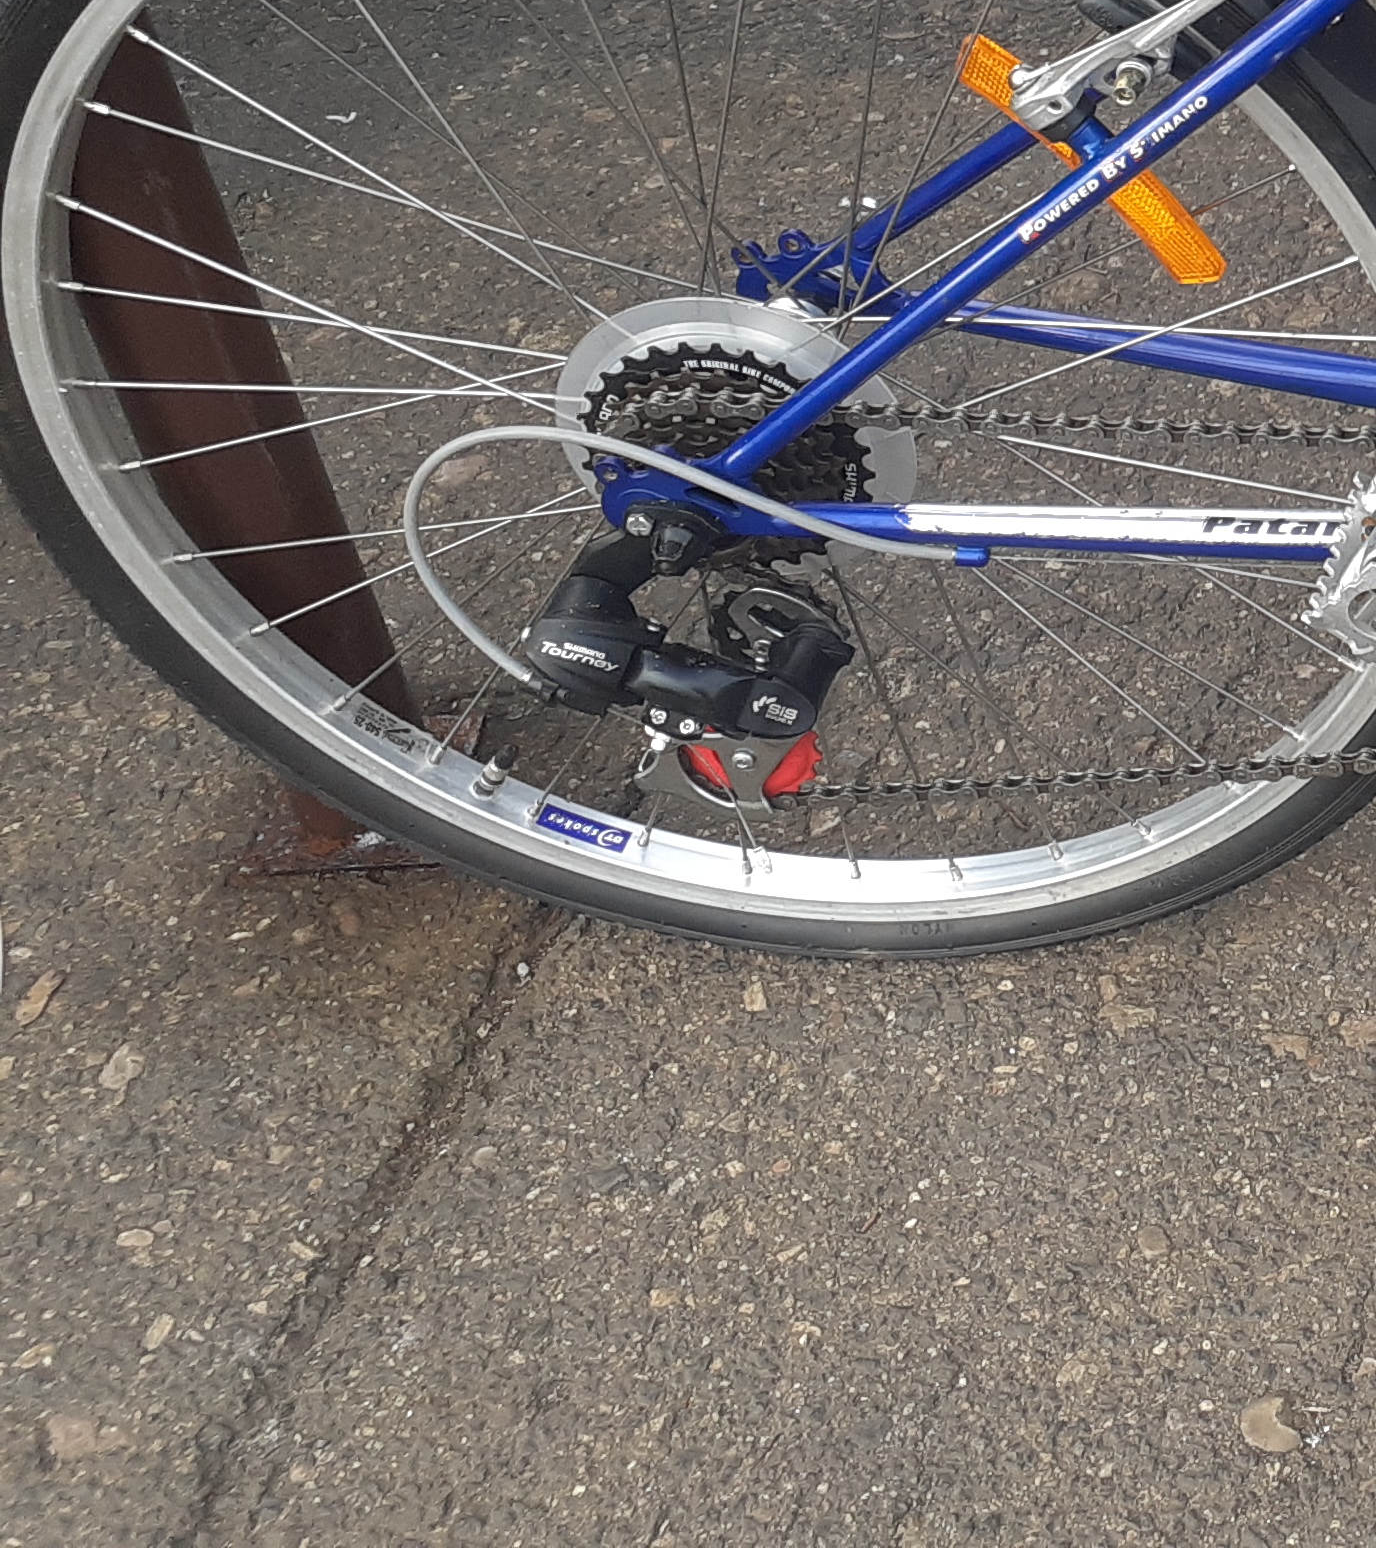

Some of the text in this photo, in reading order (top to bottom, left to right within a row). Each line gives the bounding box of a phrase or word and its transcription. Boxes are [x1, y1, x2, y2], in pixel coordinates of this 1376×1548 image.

[1018, 95, 1208, 243] POWERED BY SIMANO
[541, 640, 619, 672] Tourney
[768, 703, 798, 720] SIS
[547, 813, 600, 836] spokes
